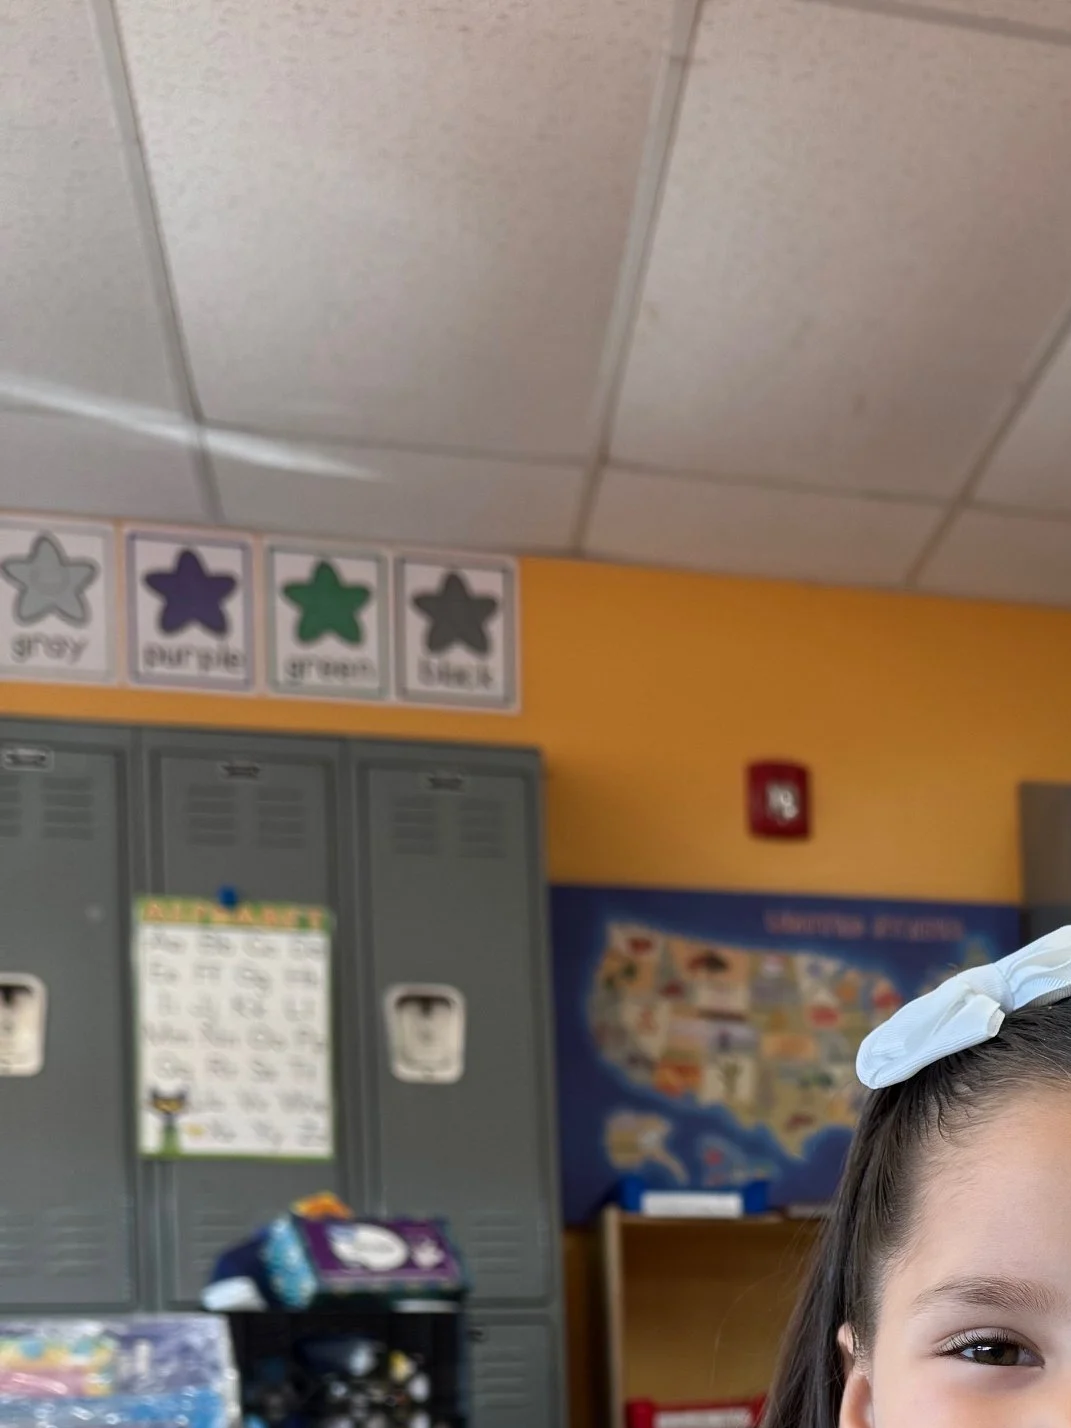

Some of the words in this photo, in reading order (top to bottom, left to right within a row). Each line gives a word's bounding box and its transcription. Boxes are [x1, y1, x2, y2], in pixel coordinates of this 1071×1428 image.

[10, 631, 89, 664] gray
[143, 641, 248, 673] purple
[285, 655, 377, 686] green
